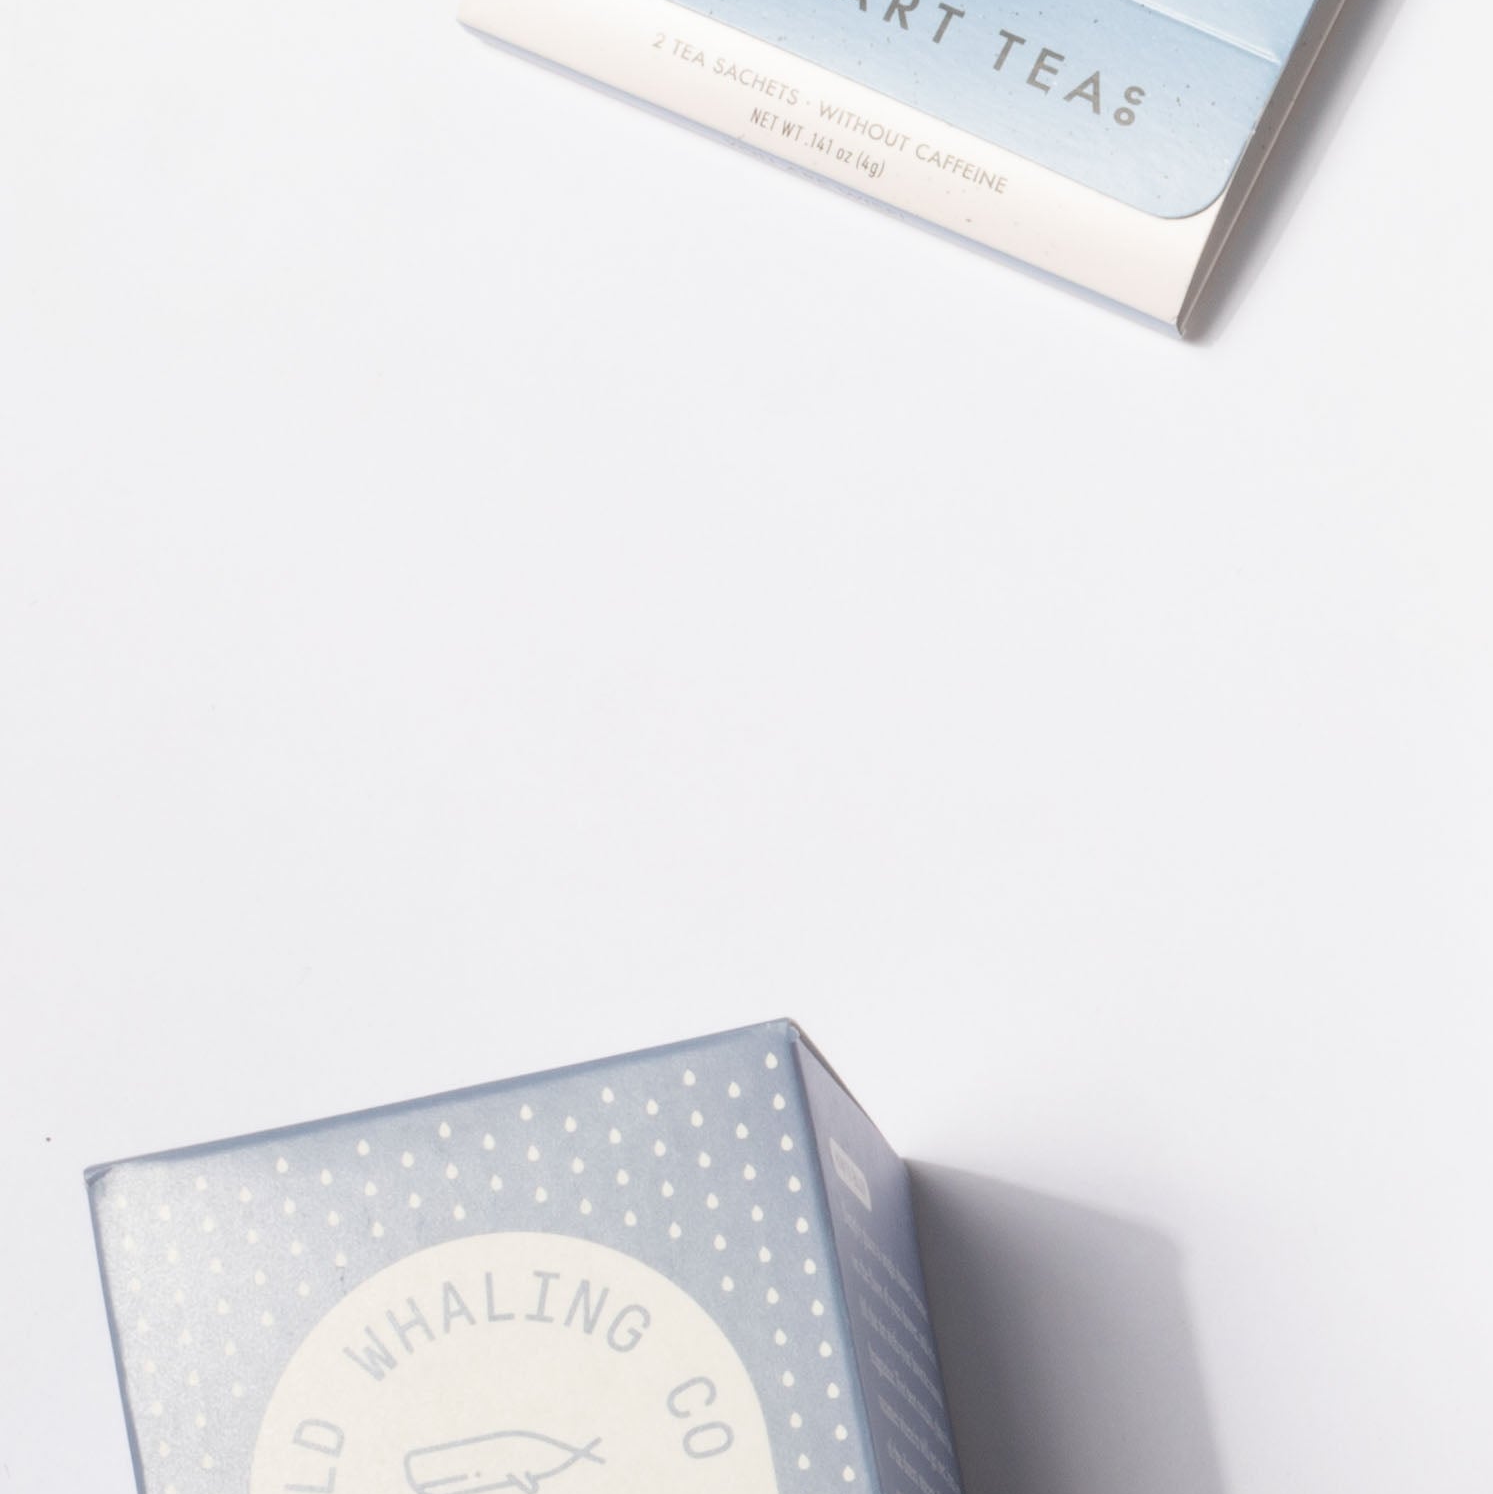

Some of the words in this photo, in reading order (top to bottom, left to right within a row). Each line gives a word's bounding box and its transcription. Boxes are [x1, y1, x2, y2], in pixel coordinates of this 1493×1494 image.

[651, 34, 666, 50] 2
[672, 38, 706, 68] TEA
[712, 57, 800, 107] SACHETS
[819, 100, 911, 153] WITHOUT
[914, 143, 1008, 195] CAFFEINE
[749, 107, 779, 132] NET
[835, 147, 854, 164] oz
[855, 151, 886, 179] (4g)
[343, 1270, 651, 1382] WHALING
[666, 1375, 735, 1459] CO
